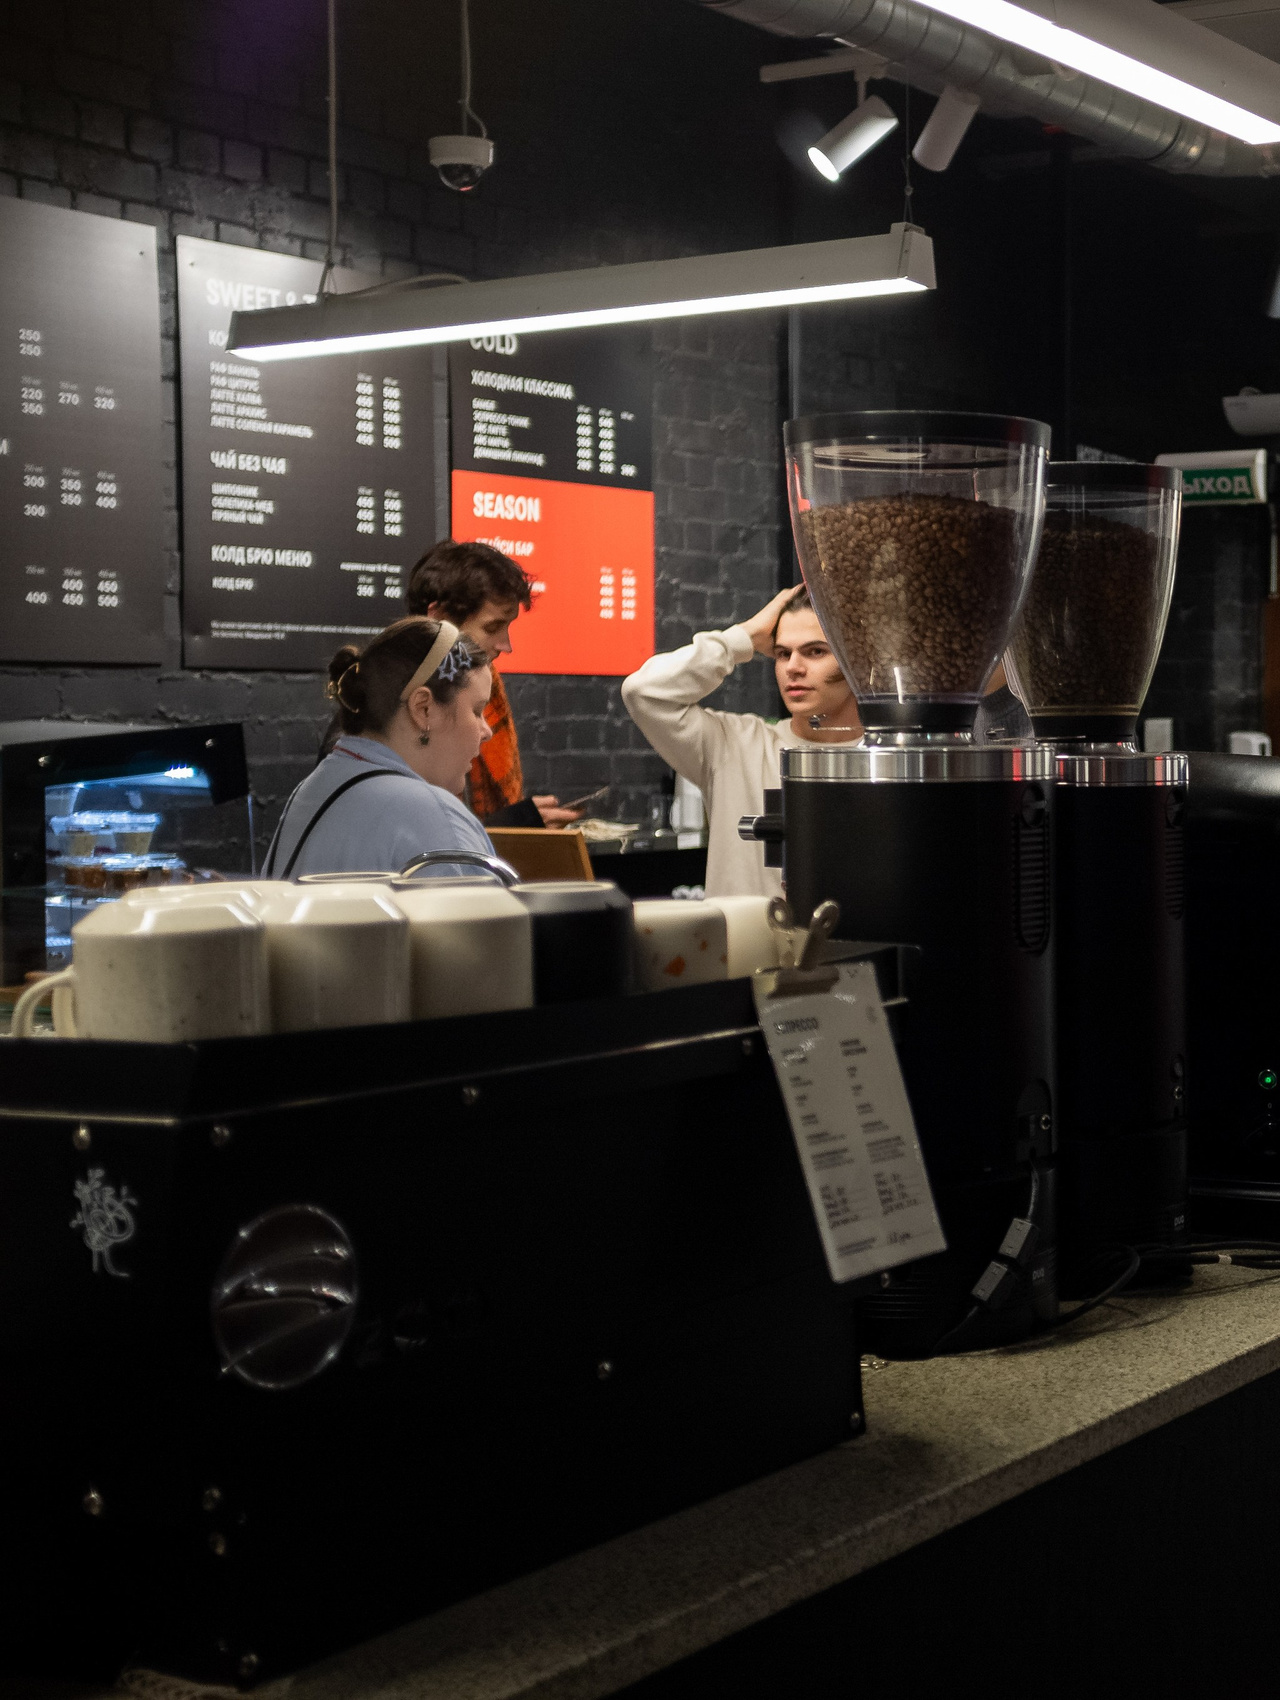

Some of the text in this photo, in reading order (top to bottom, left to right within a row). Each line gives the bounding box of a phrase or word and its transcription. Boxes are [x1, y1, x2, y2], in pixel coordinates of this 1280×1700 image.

[19, 328, 41, 342] 250
[19, 343, 42, 357] 250
[471, 369, 574, 400] ХОЛОДНАЯ КЛАССИКА
[21, 387, 116, 410] 220 270 320
[210, 449, 287, 475] ЧАЙ БЕЗ ЧАЯ
[23, 474, 117, 495] 300 350 400
[1181, 475, 1251, 496] ЫХОД
[60, 492, 118, 509] 350 400
[472, 491, 541, 522] SEASON
[23, 504, 46, 517] 300
[211, 544, 313, 568] КОЛД БРЮ МЕНЮ
[515, 540, 535, 557] БАР
[62, 579, 119, 593] 400 450
[25, 591, 119, 608] 400 450 500
